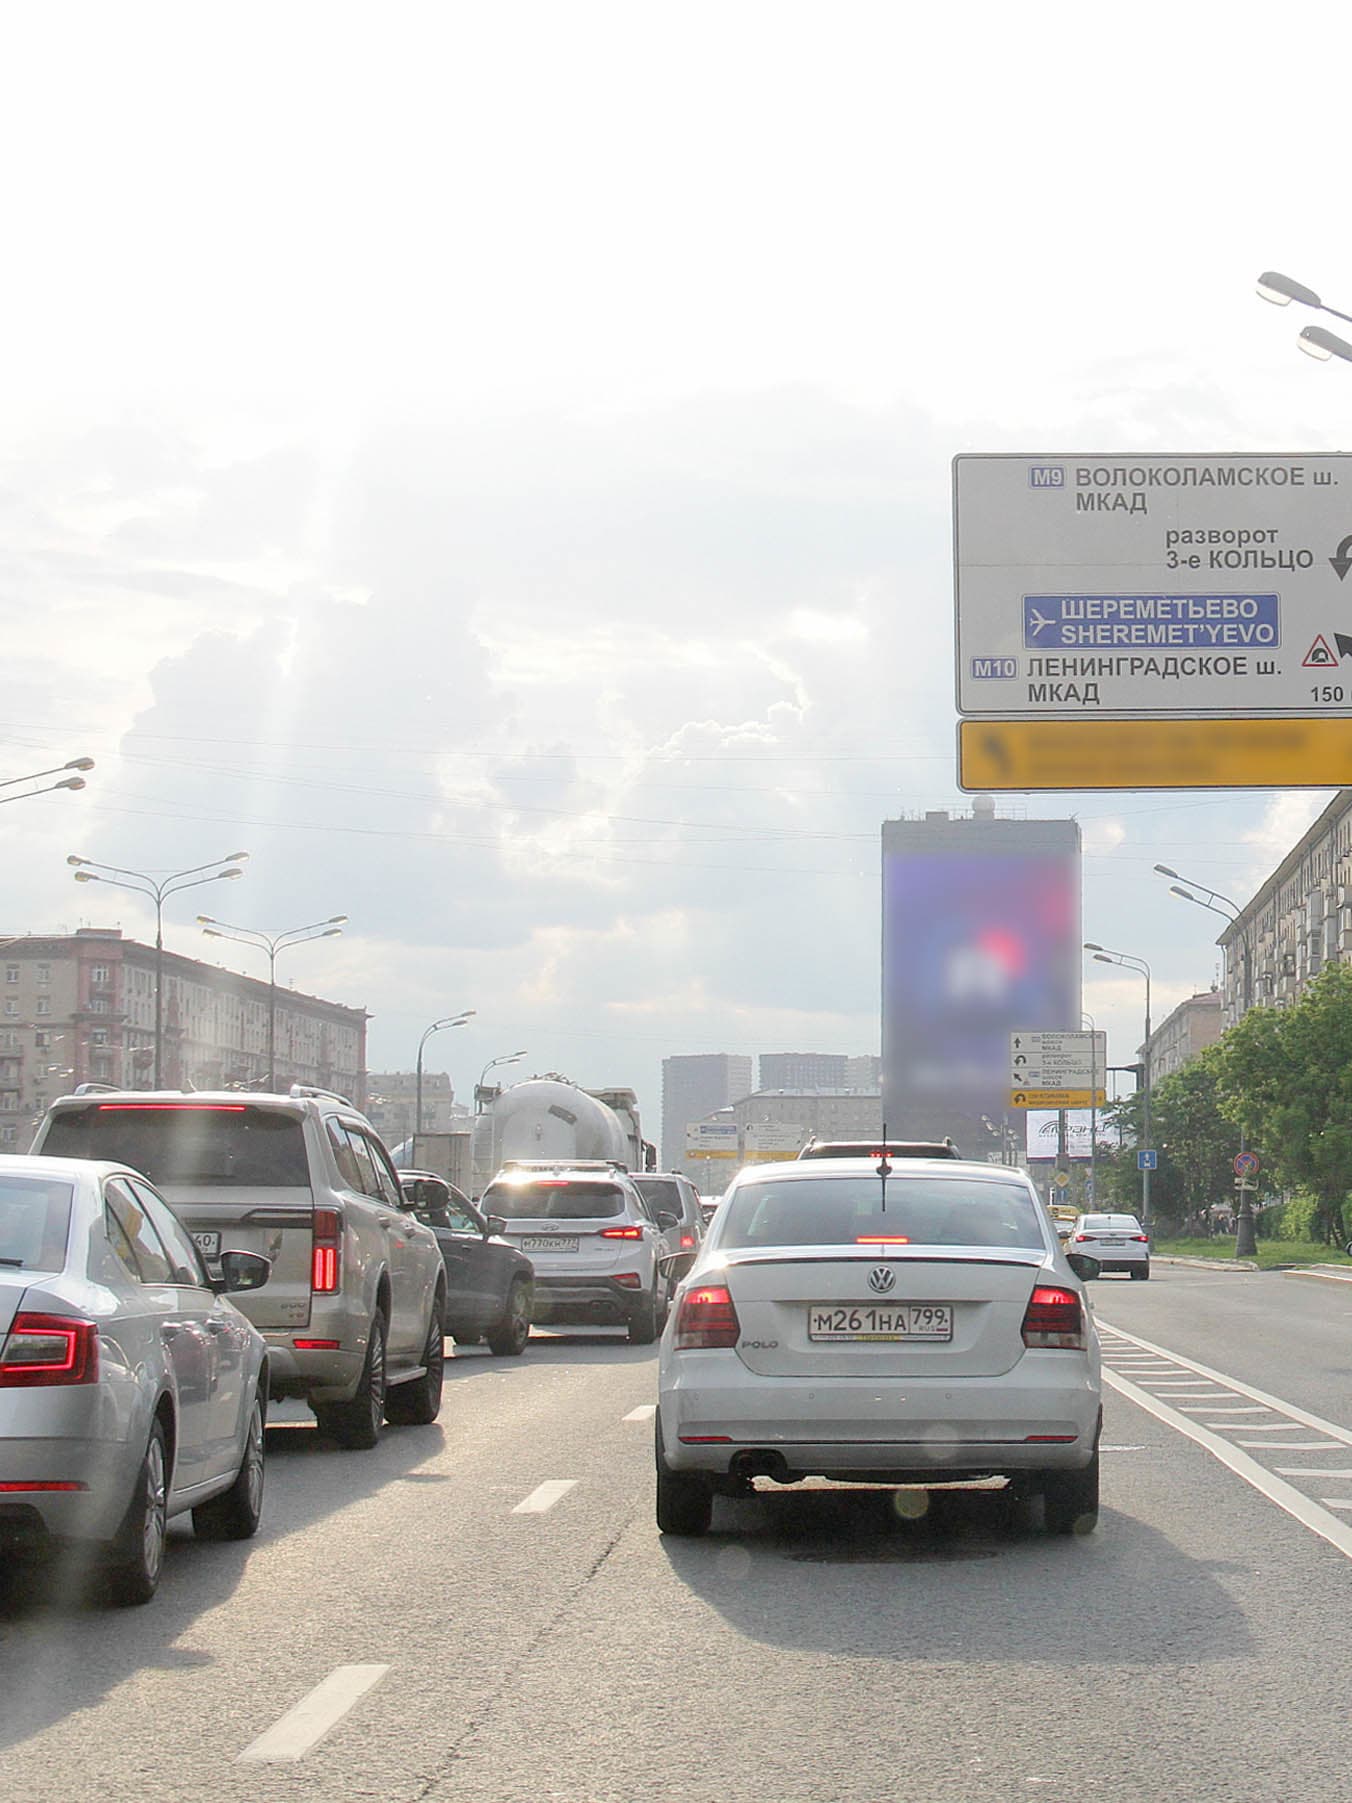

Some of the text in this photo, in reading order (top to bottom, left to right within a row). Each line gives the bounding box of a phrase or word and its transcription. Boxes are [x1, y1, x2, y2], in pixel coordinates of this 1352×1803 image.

[1075, 466, 1305, 487] ВОЛОКОЛАМСКОЕ
[1313, 471, 1339, 486] ш.
[1075, 492, 1148, 514] МКАД
[1165, 529, 1279, 549] разворот
[1166, 549, 1314, 572] 3-е КОЛЬЦО
[1061, 599, 1258, 619] ШЕРЕМЕТЬЕВО
[1026, 656, 1249, 682] ЛЕНИНГРАДСКОЕ
[1256, 660, 1283, 675] ш.
[1027, 683, 1100, 706] МКАД
[1310, 686, 1344, 702] 150
